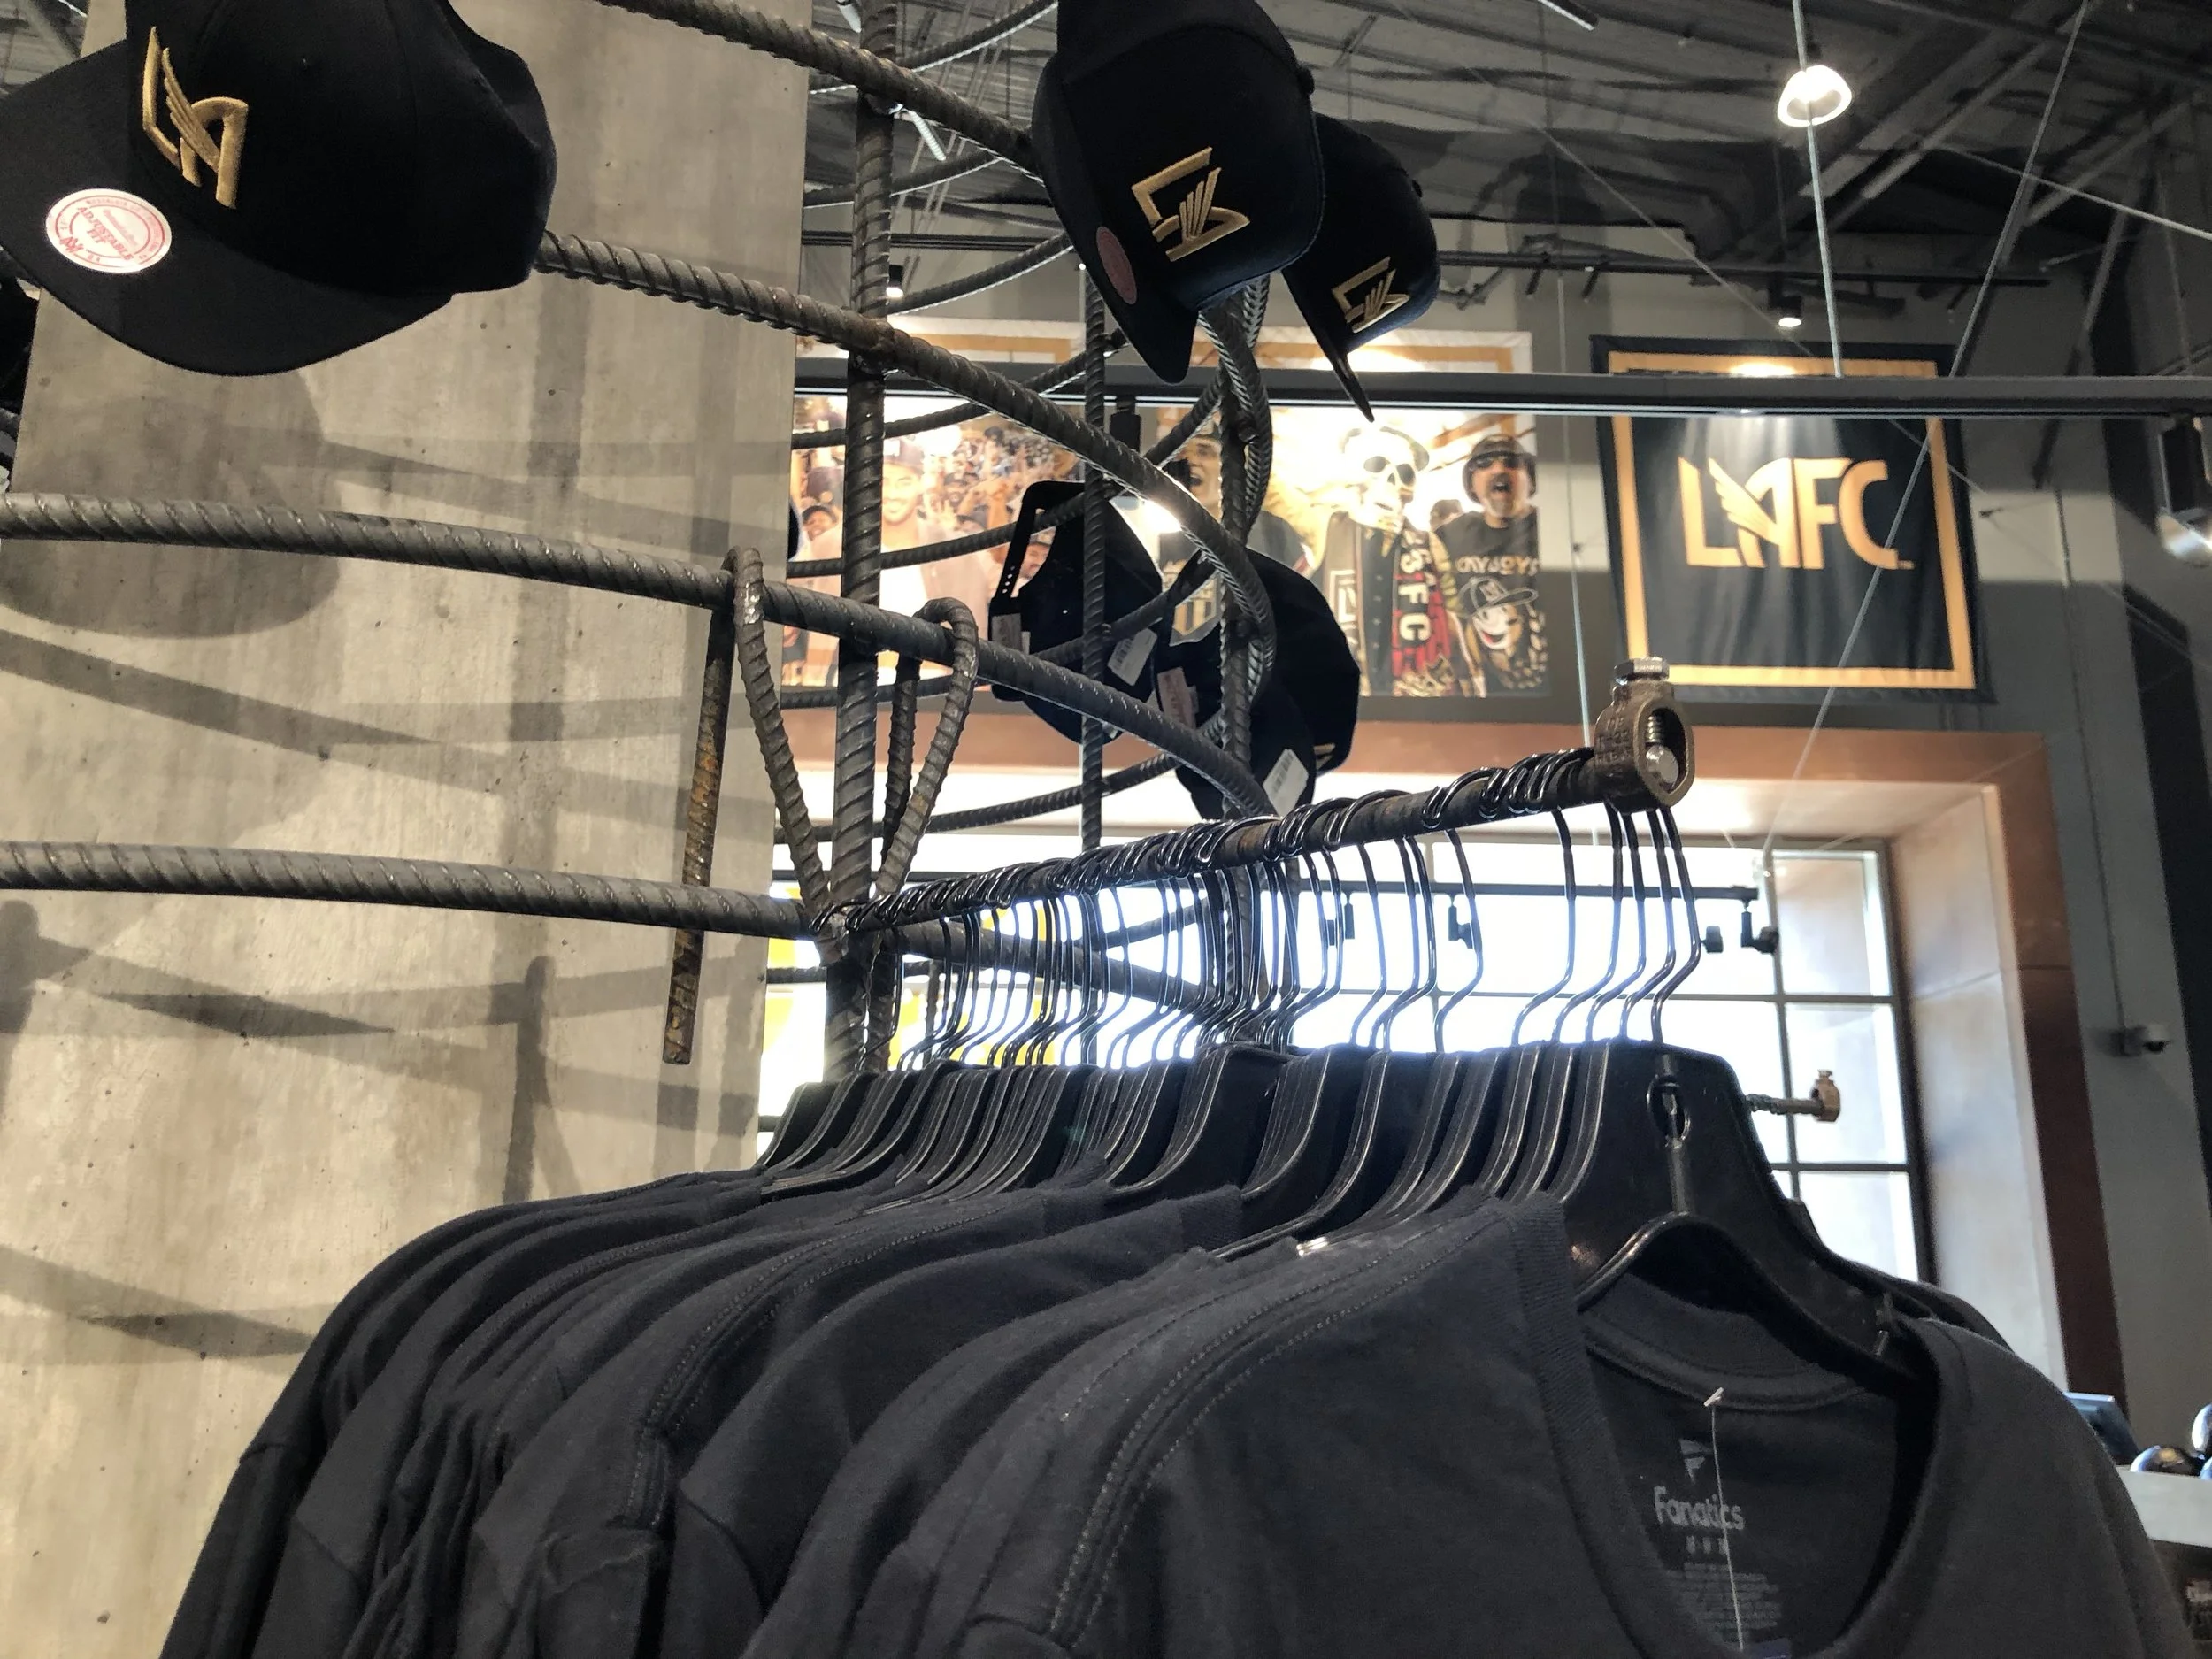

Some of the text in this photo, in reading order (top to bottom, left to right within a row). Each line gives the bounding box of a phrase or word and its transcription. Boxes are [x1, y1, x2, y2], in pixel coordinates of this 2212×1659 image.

[77, 206, 134, 261] ADJUSTABLE
[86, 228, 108, 244] FIT
[1678, 457, 1900, 570] LAFC
[1654, 1486, 1746, 1531] Fanatics
